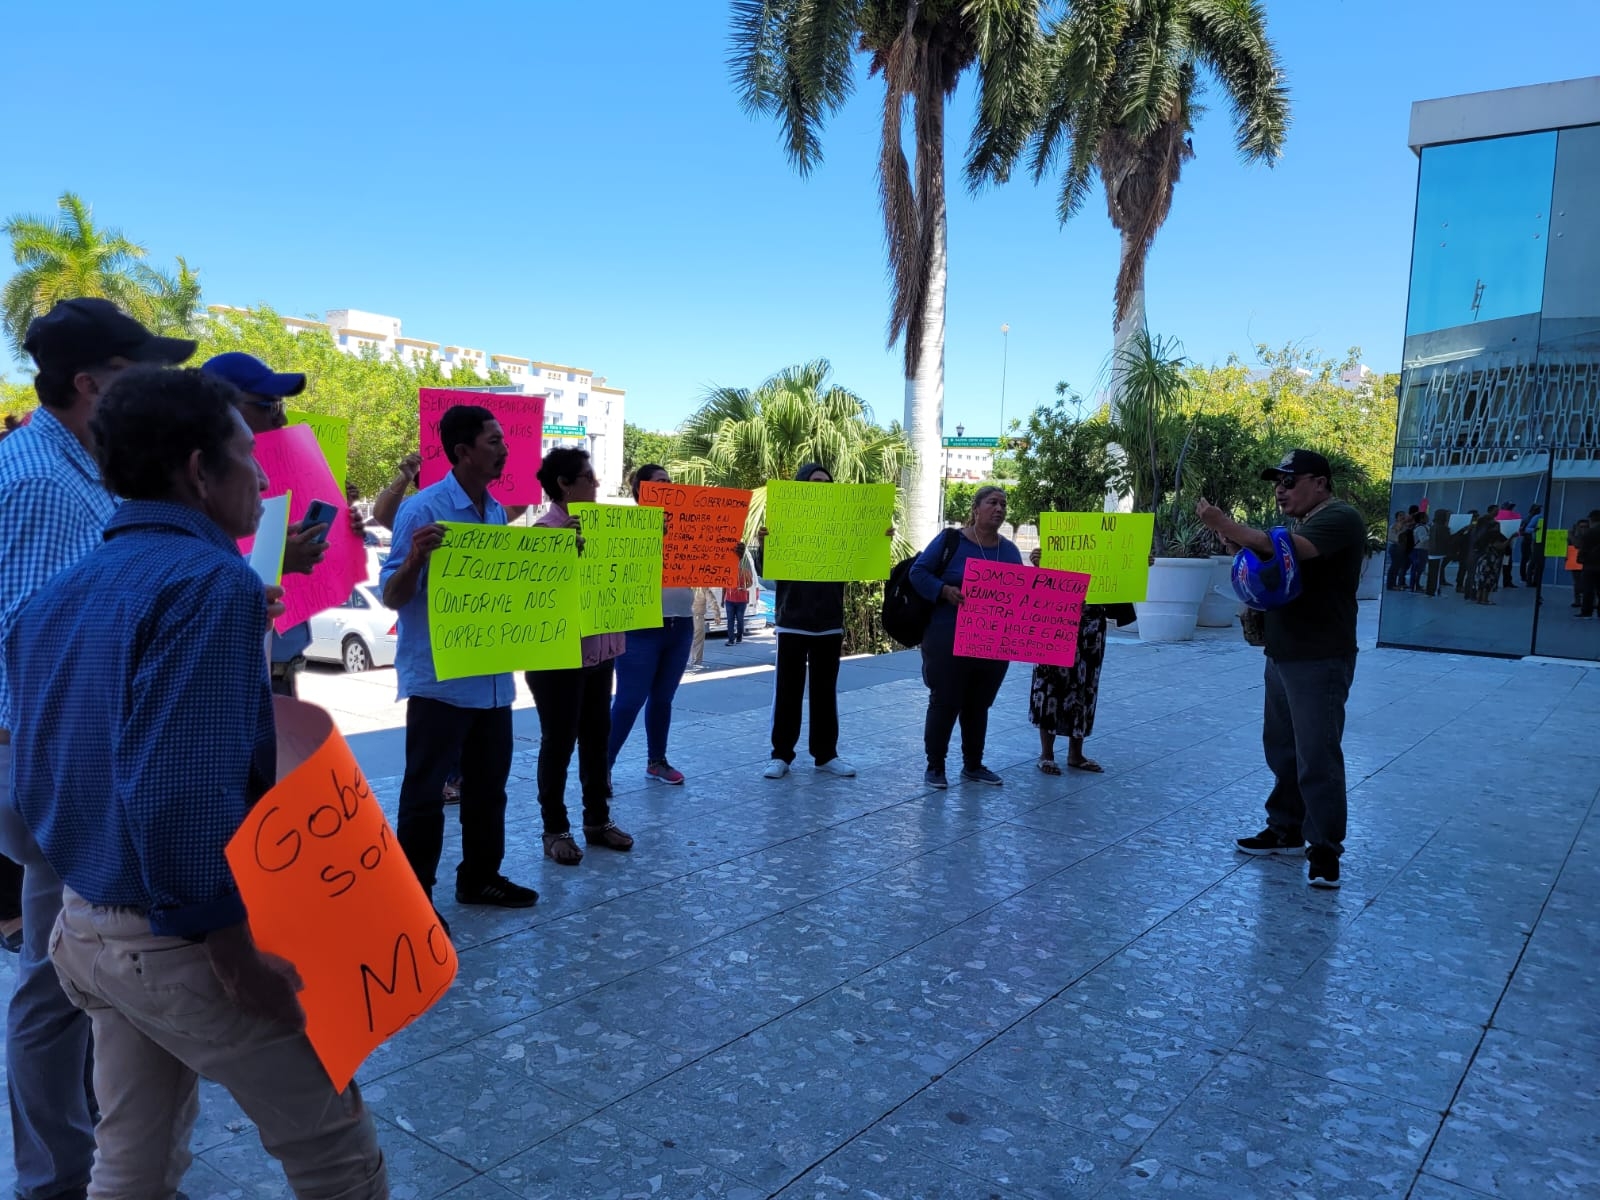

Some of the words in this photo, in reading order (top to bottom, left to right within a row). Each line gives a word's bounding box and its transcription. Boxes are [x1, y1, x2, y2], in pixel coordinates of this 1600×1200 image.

[641, 485, 687, 507] USTED
[580, 508, 600, 531] POR
[606, 507, 622, 529] SER
[1101, 515, 1117, 532] NO
[440, 528, 511, 550] QUEREMOS
[517, 534, 575, 553] NUESTRA
[605, 536, 662, 559] DESPIDIERON
[1047, 534, 1097, 552] PROTEJAS
[714, 553, 727, 561] DE
[1121, 553, 1135, 570] DE
[580, 564, 603, 586] HACE
[609, 563, 618, 583] 5
[647, 564, 654, 585] Y
[698, 563, 731, 575] HASTA
[965, 560, 1025, 587] SOMOS
[702, 574, 734, 585] CLARO
[434, 587, 512, 613] CONFORME
[524, 588, 557, 611] NOS
[597, 587, 617, 606] NOS
[965, 585, 1014, 604] VENIMOS
[1019, 594, 1030, 608] A
[1033, 600, 1079, 614] EXIGIR
[959, 603, 1014, 618] NUESTRA
[435, 618, 568, 650] CORRESPONDA
[976, 617, 998, 631] QUE
[1004, 622, 1036, 636] HACE
